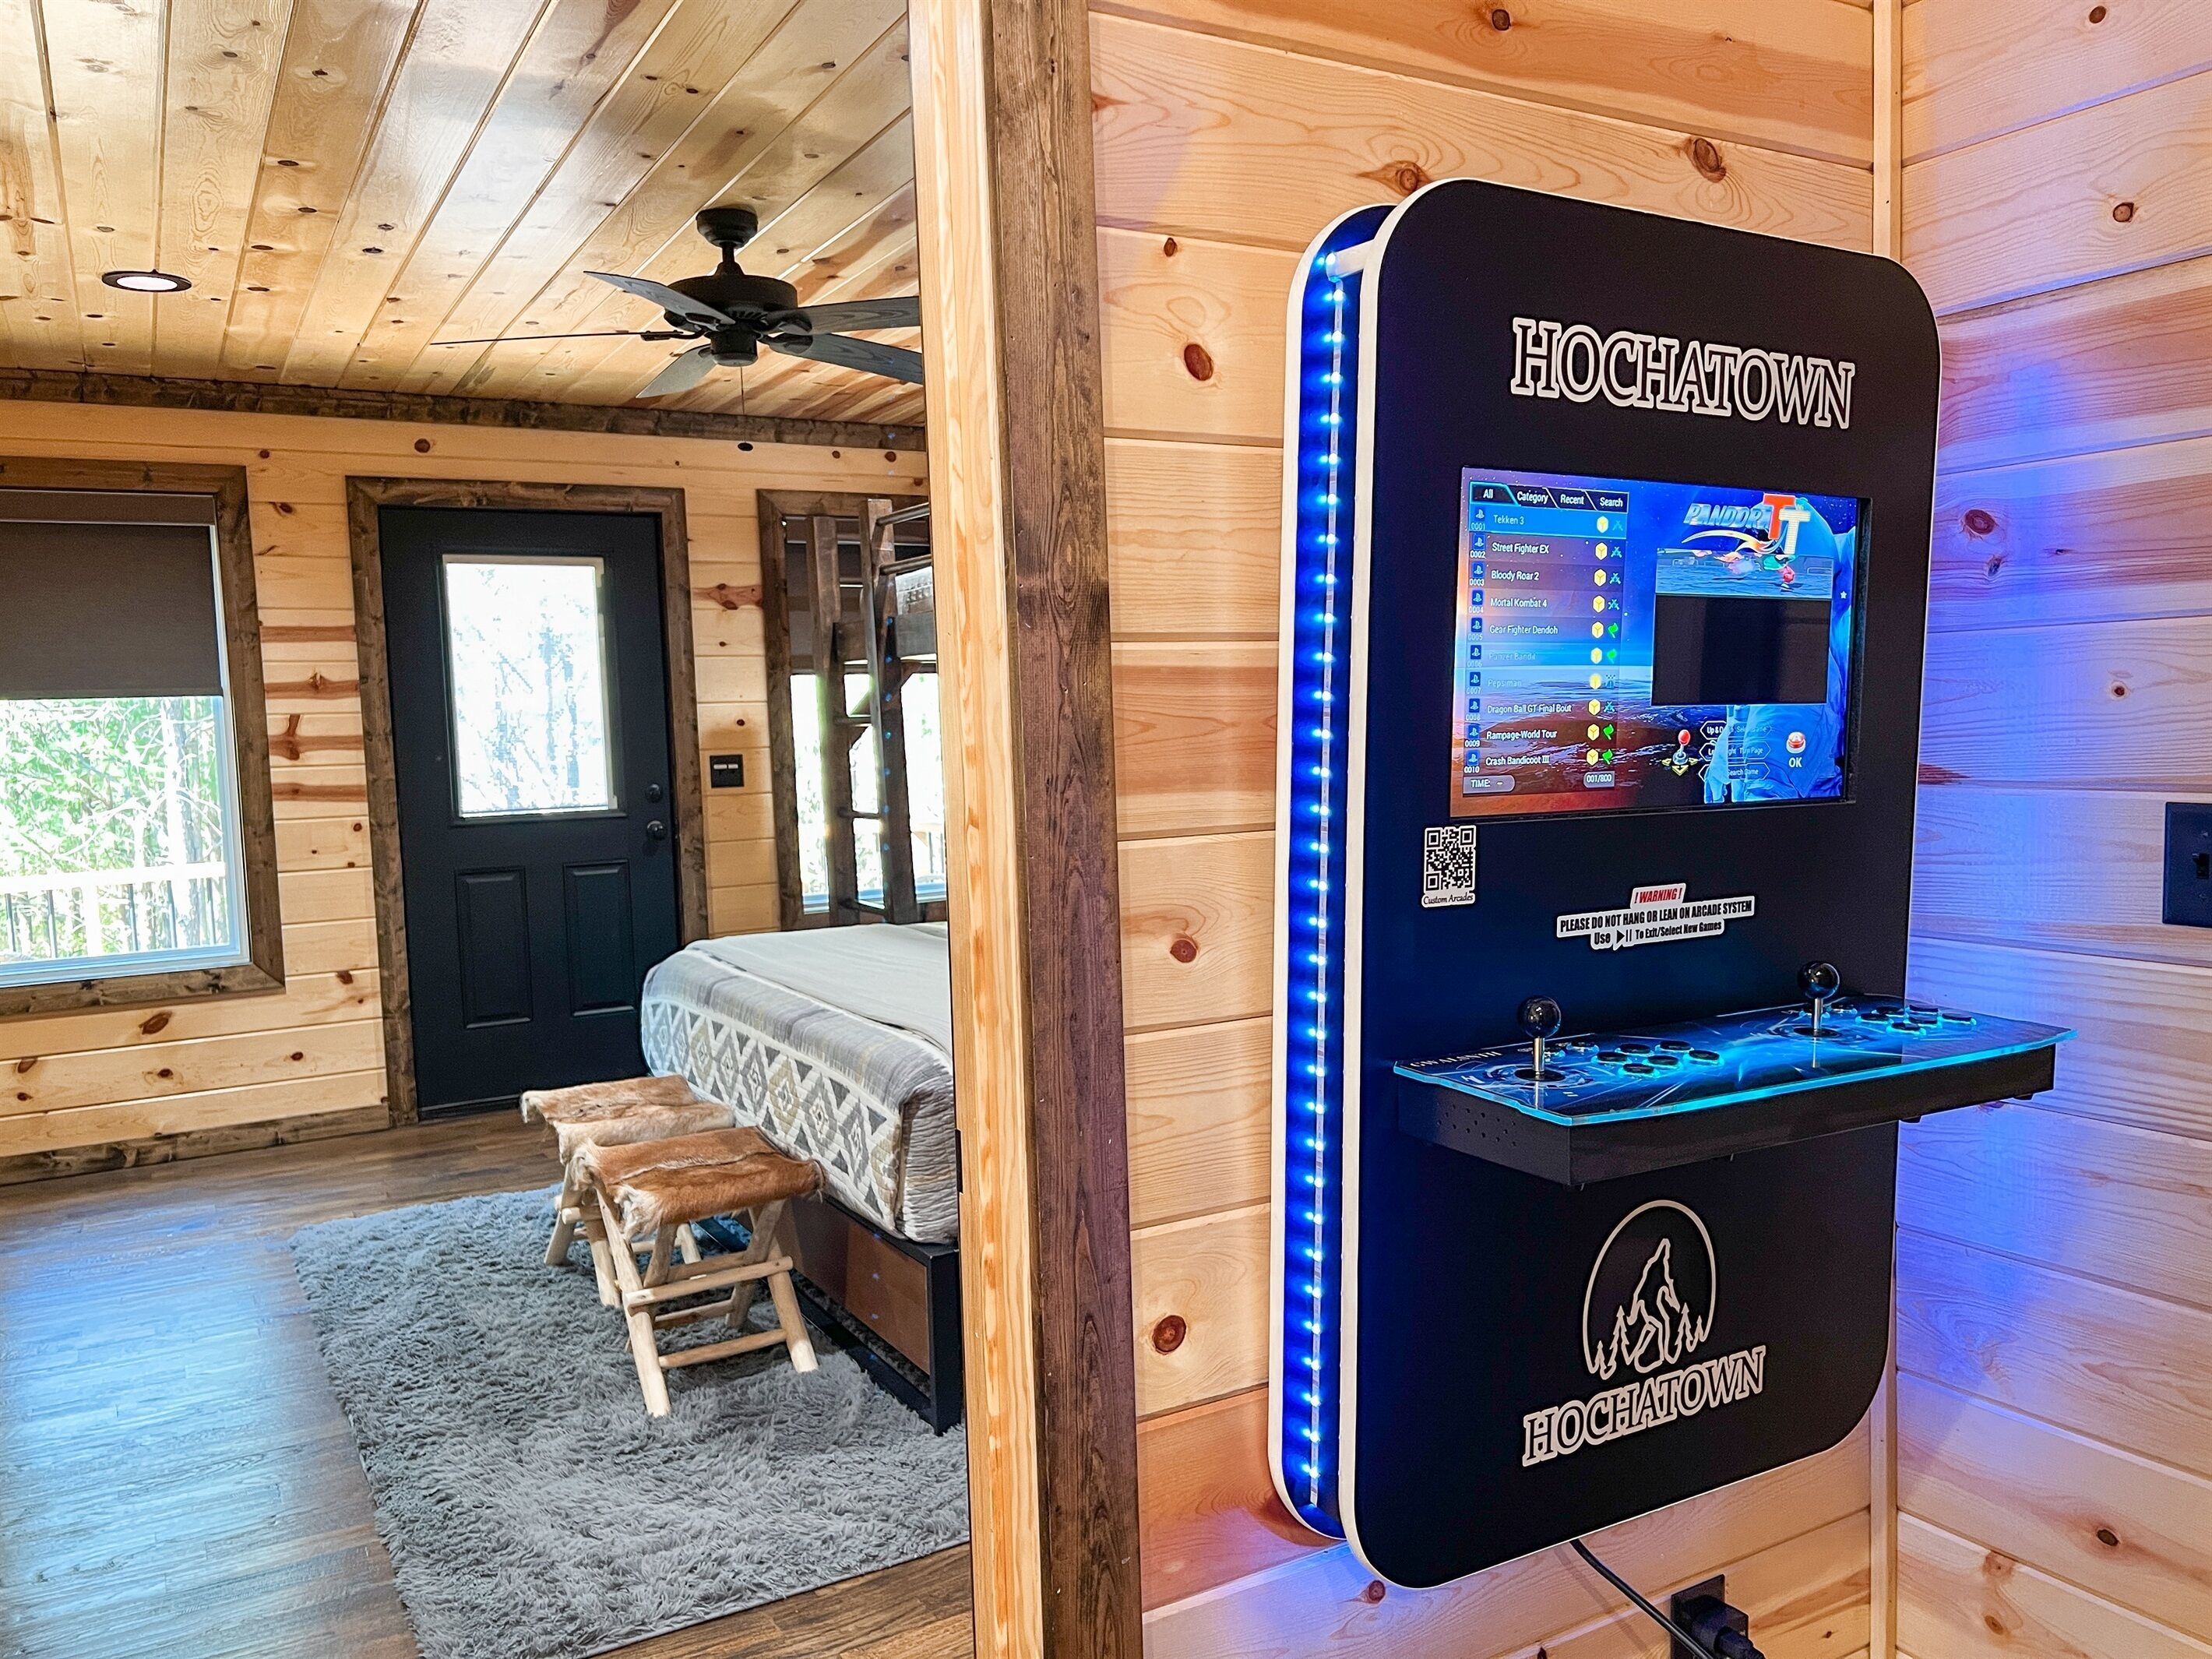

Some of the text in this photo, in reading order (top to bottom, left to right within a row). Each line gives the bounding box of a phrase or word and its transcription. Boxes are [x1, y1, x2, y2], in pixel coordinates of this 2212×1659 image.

[1510, 317, 1855, 429] HOCHATOWN
[1483, 489, 1493, 498] All
[1517, 491, 1548, 504] Category
[1561, 495, 1584, 505] Recent
[1600, 498, 1623, 507] Search
[1493, 515, 1524, 525] Tekken 3
[1492, 543, 1549, 555] Street Fighter EX
[1492, 571, 1539, 582] Bloody Roar 2
[1490, 597, 1548, 608] Mortal Kombat 4
[1490, 625, 1558, 636] Gear Fighter Dendoh
[1488, 706, 1512, 714] Dragon
[1541, 730, 1557, 738] Tour
[1486, 756, 1506, 766] Crash
[1507, 756, 1541, 765] Bandicoot
[1789, 757, 1802, 767] OK
[1587, 773, 1612, 784] 001/800
[1449, 892, 1473, 902] Arcades
[1640, 889, 1678, 903] WARNING
[1560, 900, 1752, 932] PLEASE DO NOT HANG OR LEAN ON ARCADE SYSTEM
[1594, 921, 1721, 945] Use To Exit/Select New Games
[1522, 1345, 1766, 1467] HOCHATOWN
